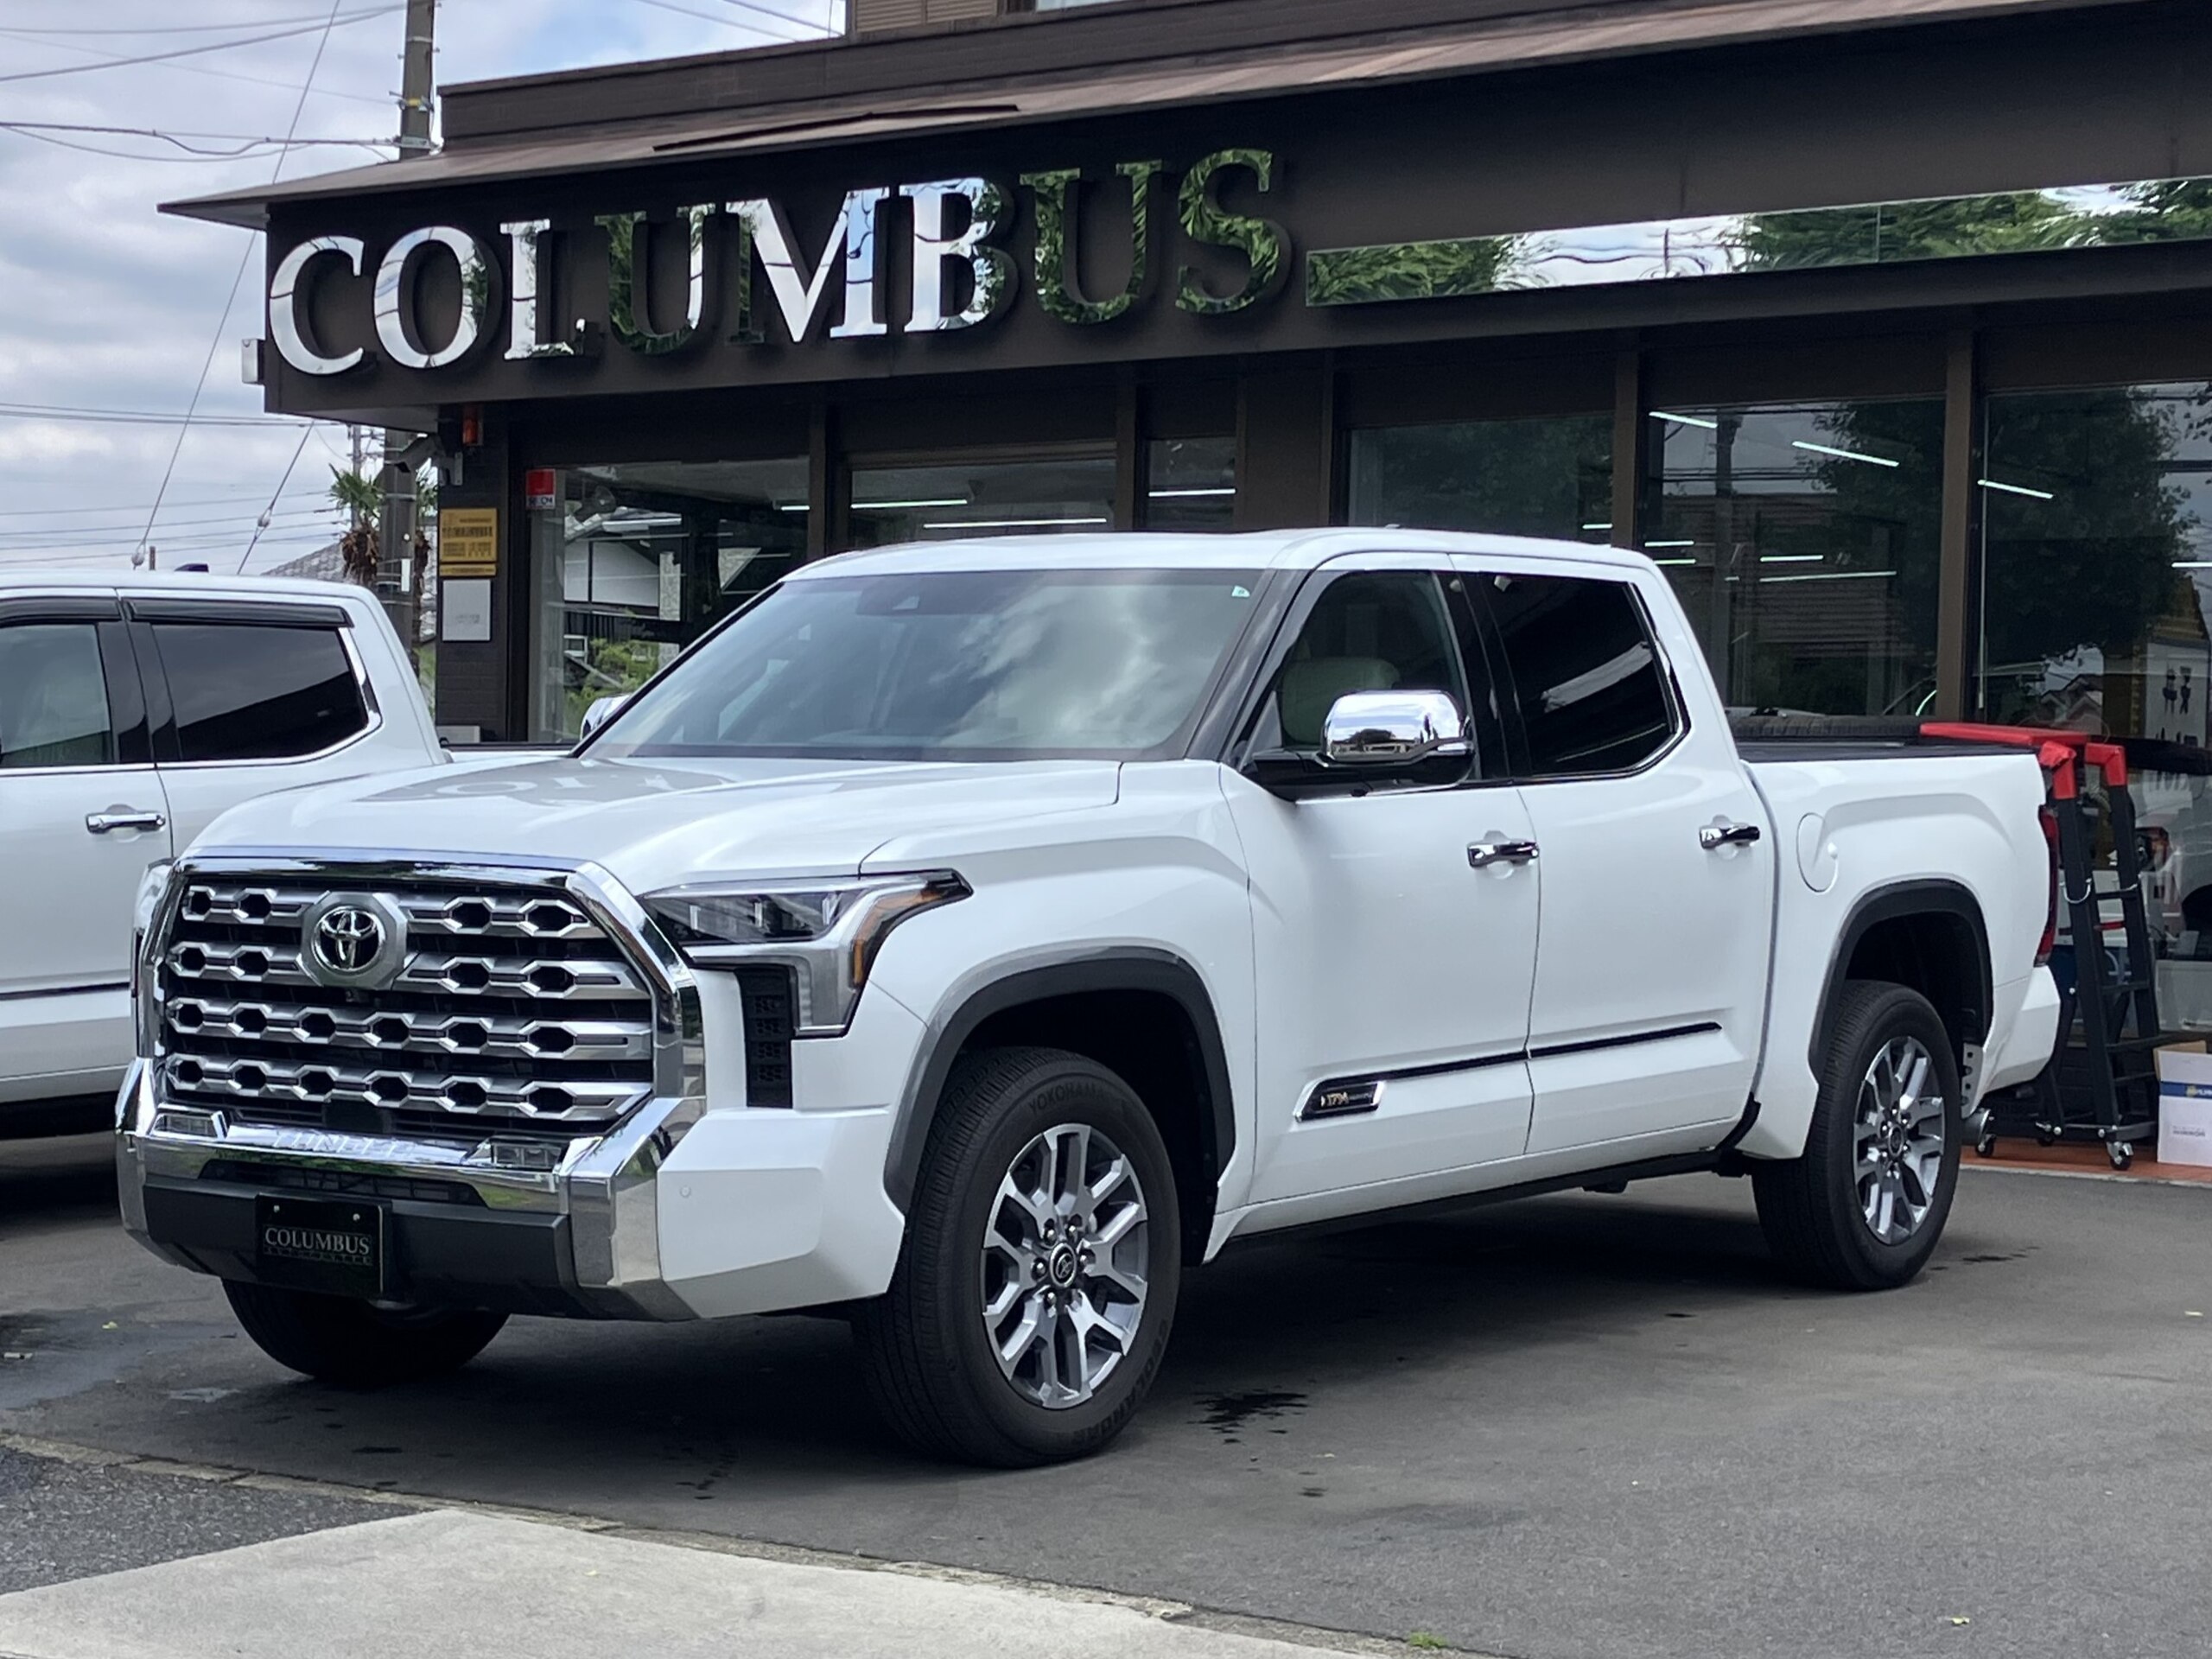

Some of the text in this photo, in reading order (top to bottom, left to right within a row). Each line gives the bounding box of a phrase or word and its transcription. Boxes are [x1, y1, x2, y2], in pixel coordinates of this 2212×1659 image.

[269, 149, 1282, 377] COLUMBUS
[1028, 1081, 1107, 1115] YOKOHAMA
[264, 1227, 370, 1255] COLUMBUS
